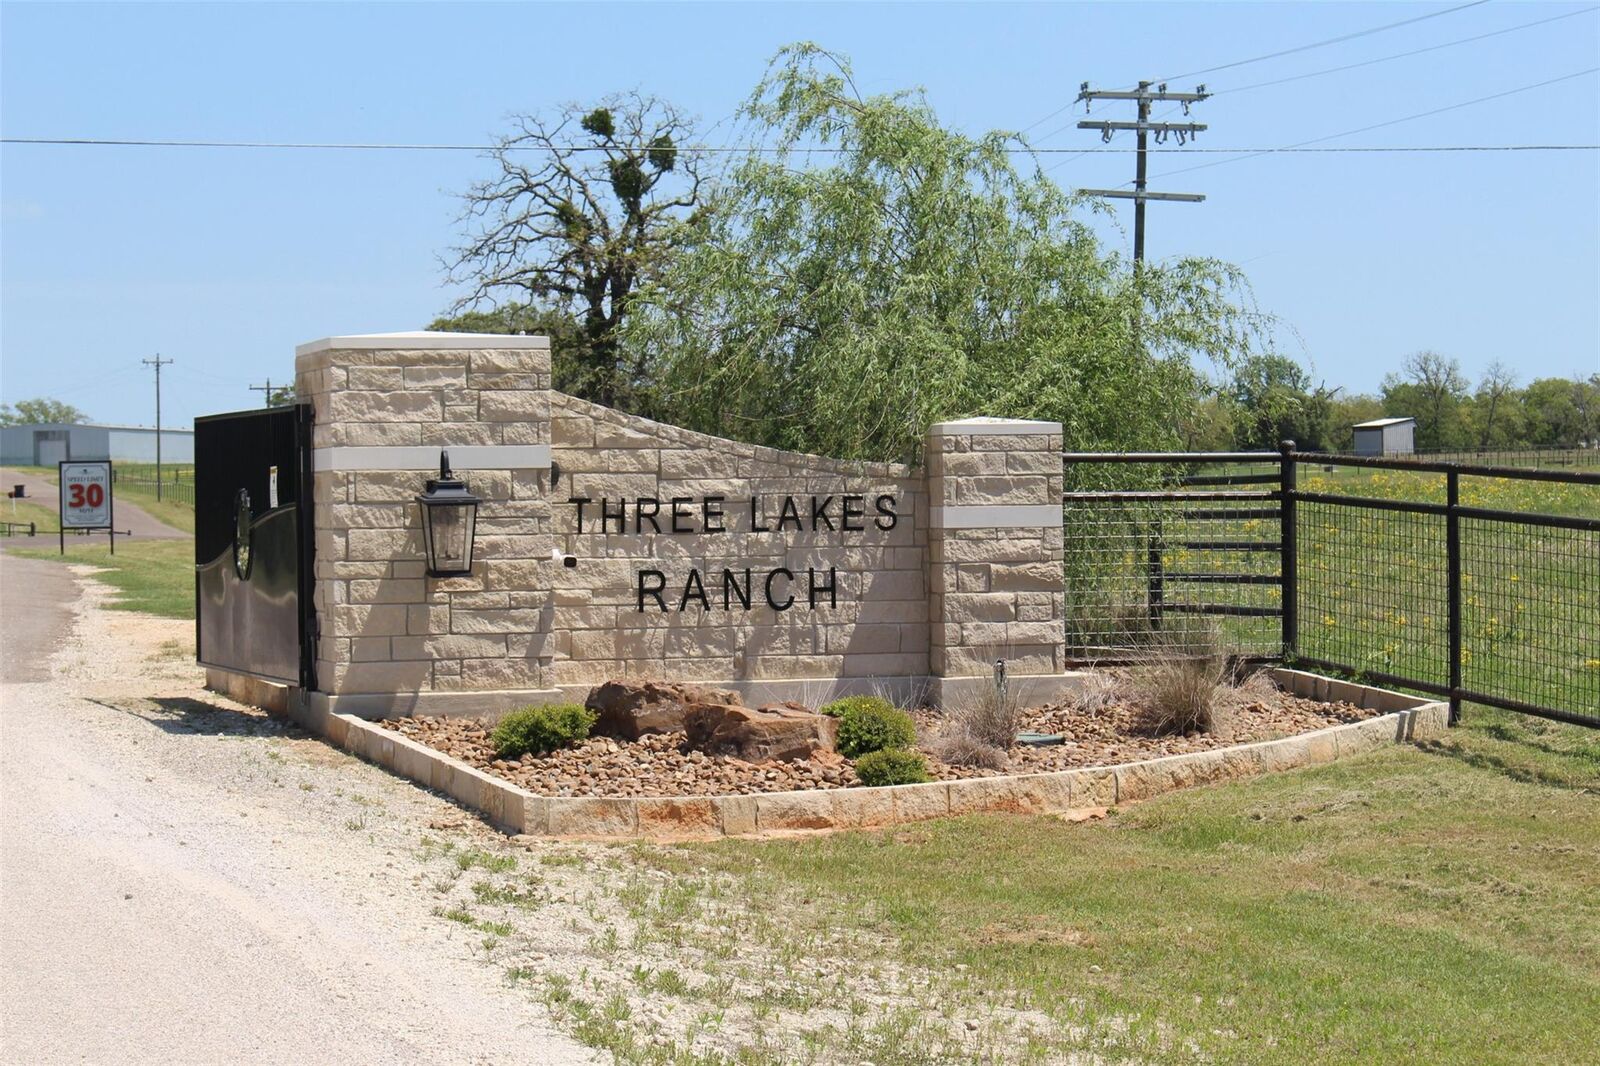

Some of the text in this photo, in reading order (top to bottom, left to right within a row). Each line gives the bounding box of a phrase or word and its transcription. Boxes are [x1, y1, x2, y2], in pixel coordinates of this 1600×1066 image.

[69, 484, 104, 508] 30
[568, 495, 898, 534] THREE LAKES
[638, 567, 837, 613] RANCH
